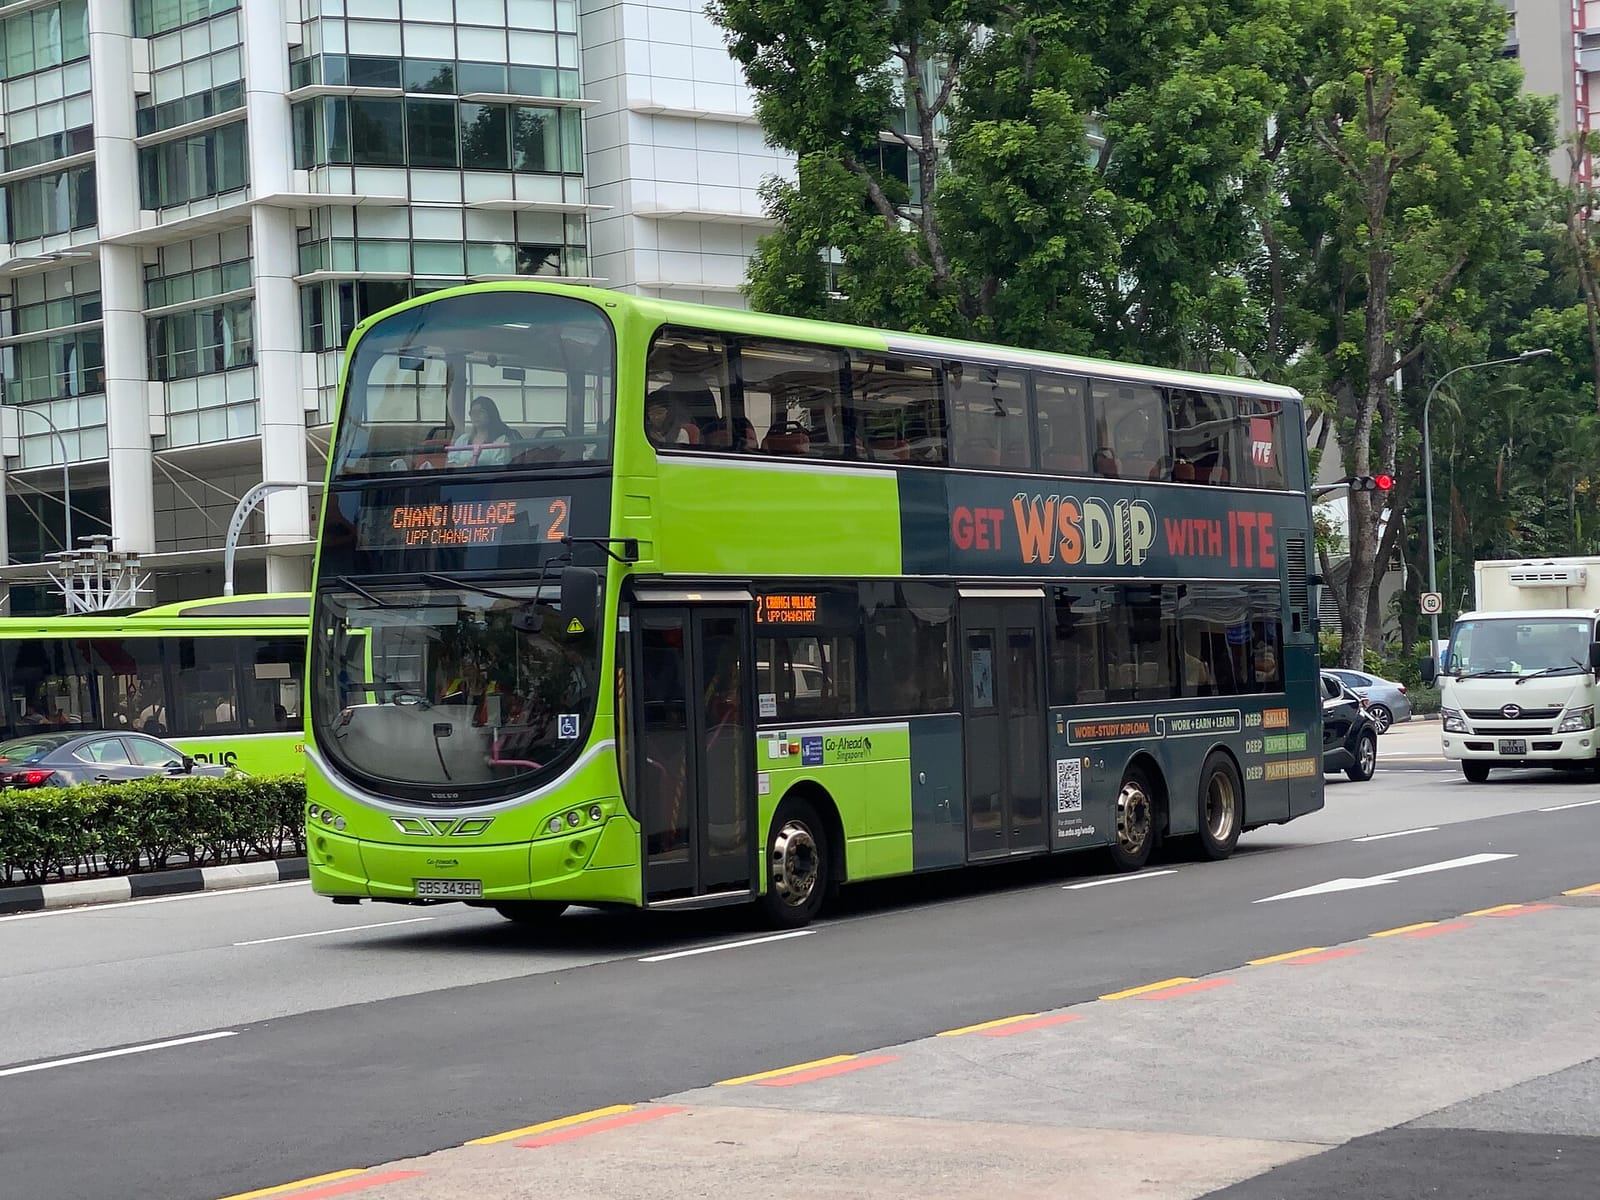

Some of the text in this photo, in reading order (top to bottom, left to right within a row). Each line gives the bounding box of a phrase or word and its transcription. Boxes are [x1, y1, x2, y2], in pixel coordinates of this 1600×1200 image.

[1252, 441, 1272, 464] ITE
[392, 501, 517, 529] CHANGI VILLAGE
[547, 499, 568, 540] 2
[405, 526, 498, 545] UPP CHANGI MRT
[952, 492, 1276, 569] GET WSDIP WITH ITE
[756, 595, 763, 622] 2
[1245, 711, 1287, 727] DEEP SKILLS
[1074, 722, 1150, 738] WORK-STUDY DIPLOMA
[825, 737, 863, 751] Go-Ahead
[1245, 736, 1305, 753] DEEP EXPERIENCE
[836, 750, 864, 761] Singapore
[1246, 761, 1314, 780] DEEP PARTNERSHIPS
[418, 881, 480, 895] SBS3436H
